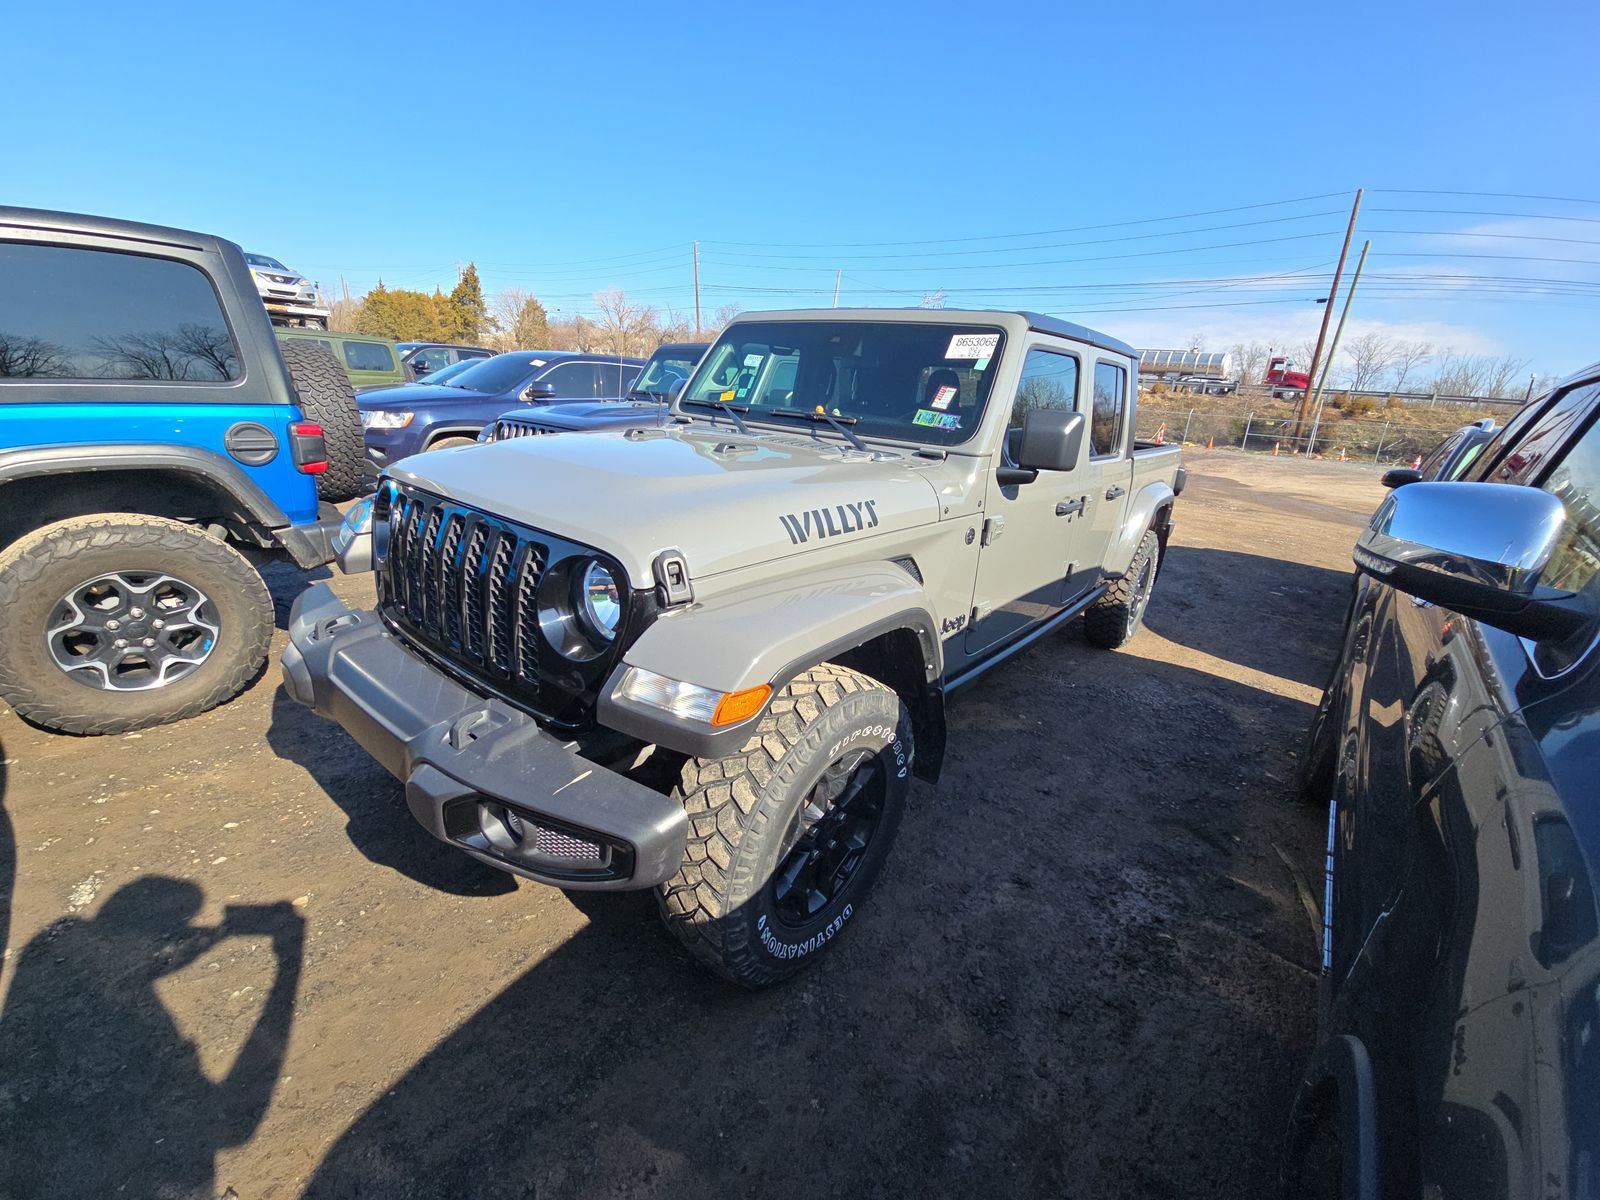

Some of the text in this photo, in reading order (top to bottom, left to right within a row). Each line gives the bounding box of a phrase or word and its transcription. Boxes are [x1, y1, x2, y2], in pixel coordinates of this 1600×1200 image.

[779, 499, 879, 545] WILLYS
[940, 614, 966, 636] Jeep
[760, 903, 854, 960] DESTINATION
